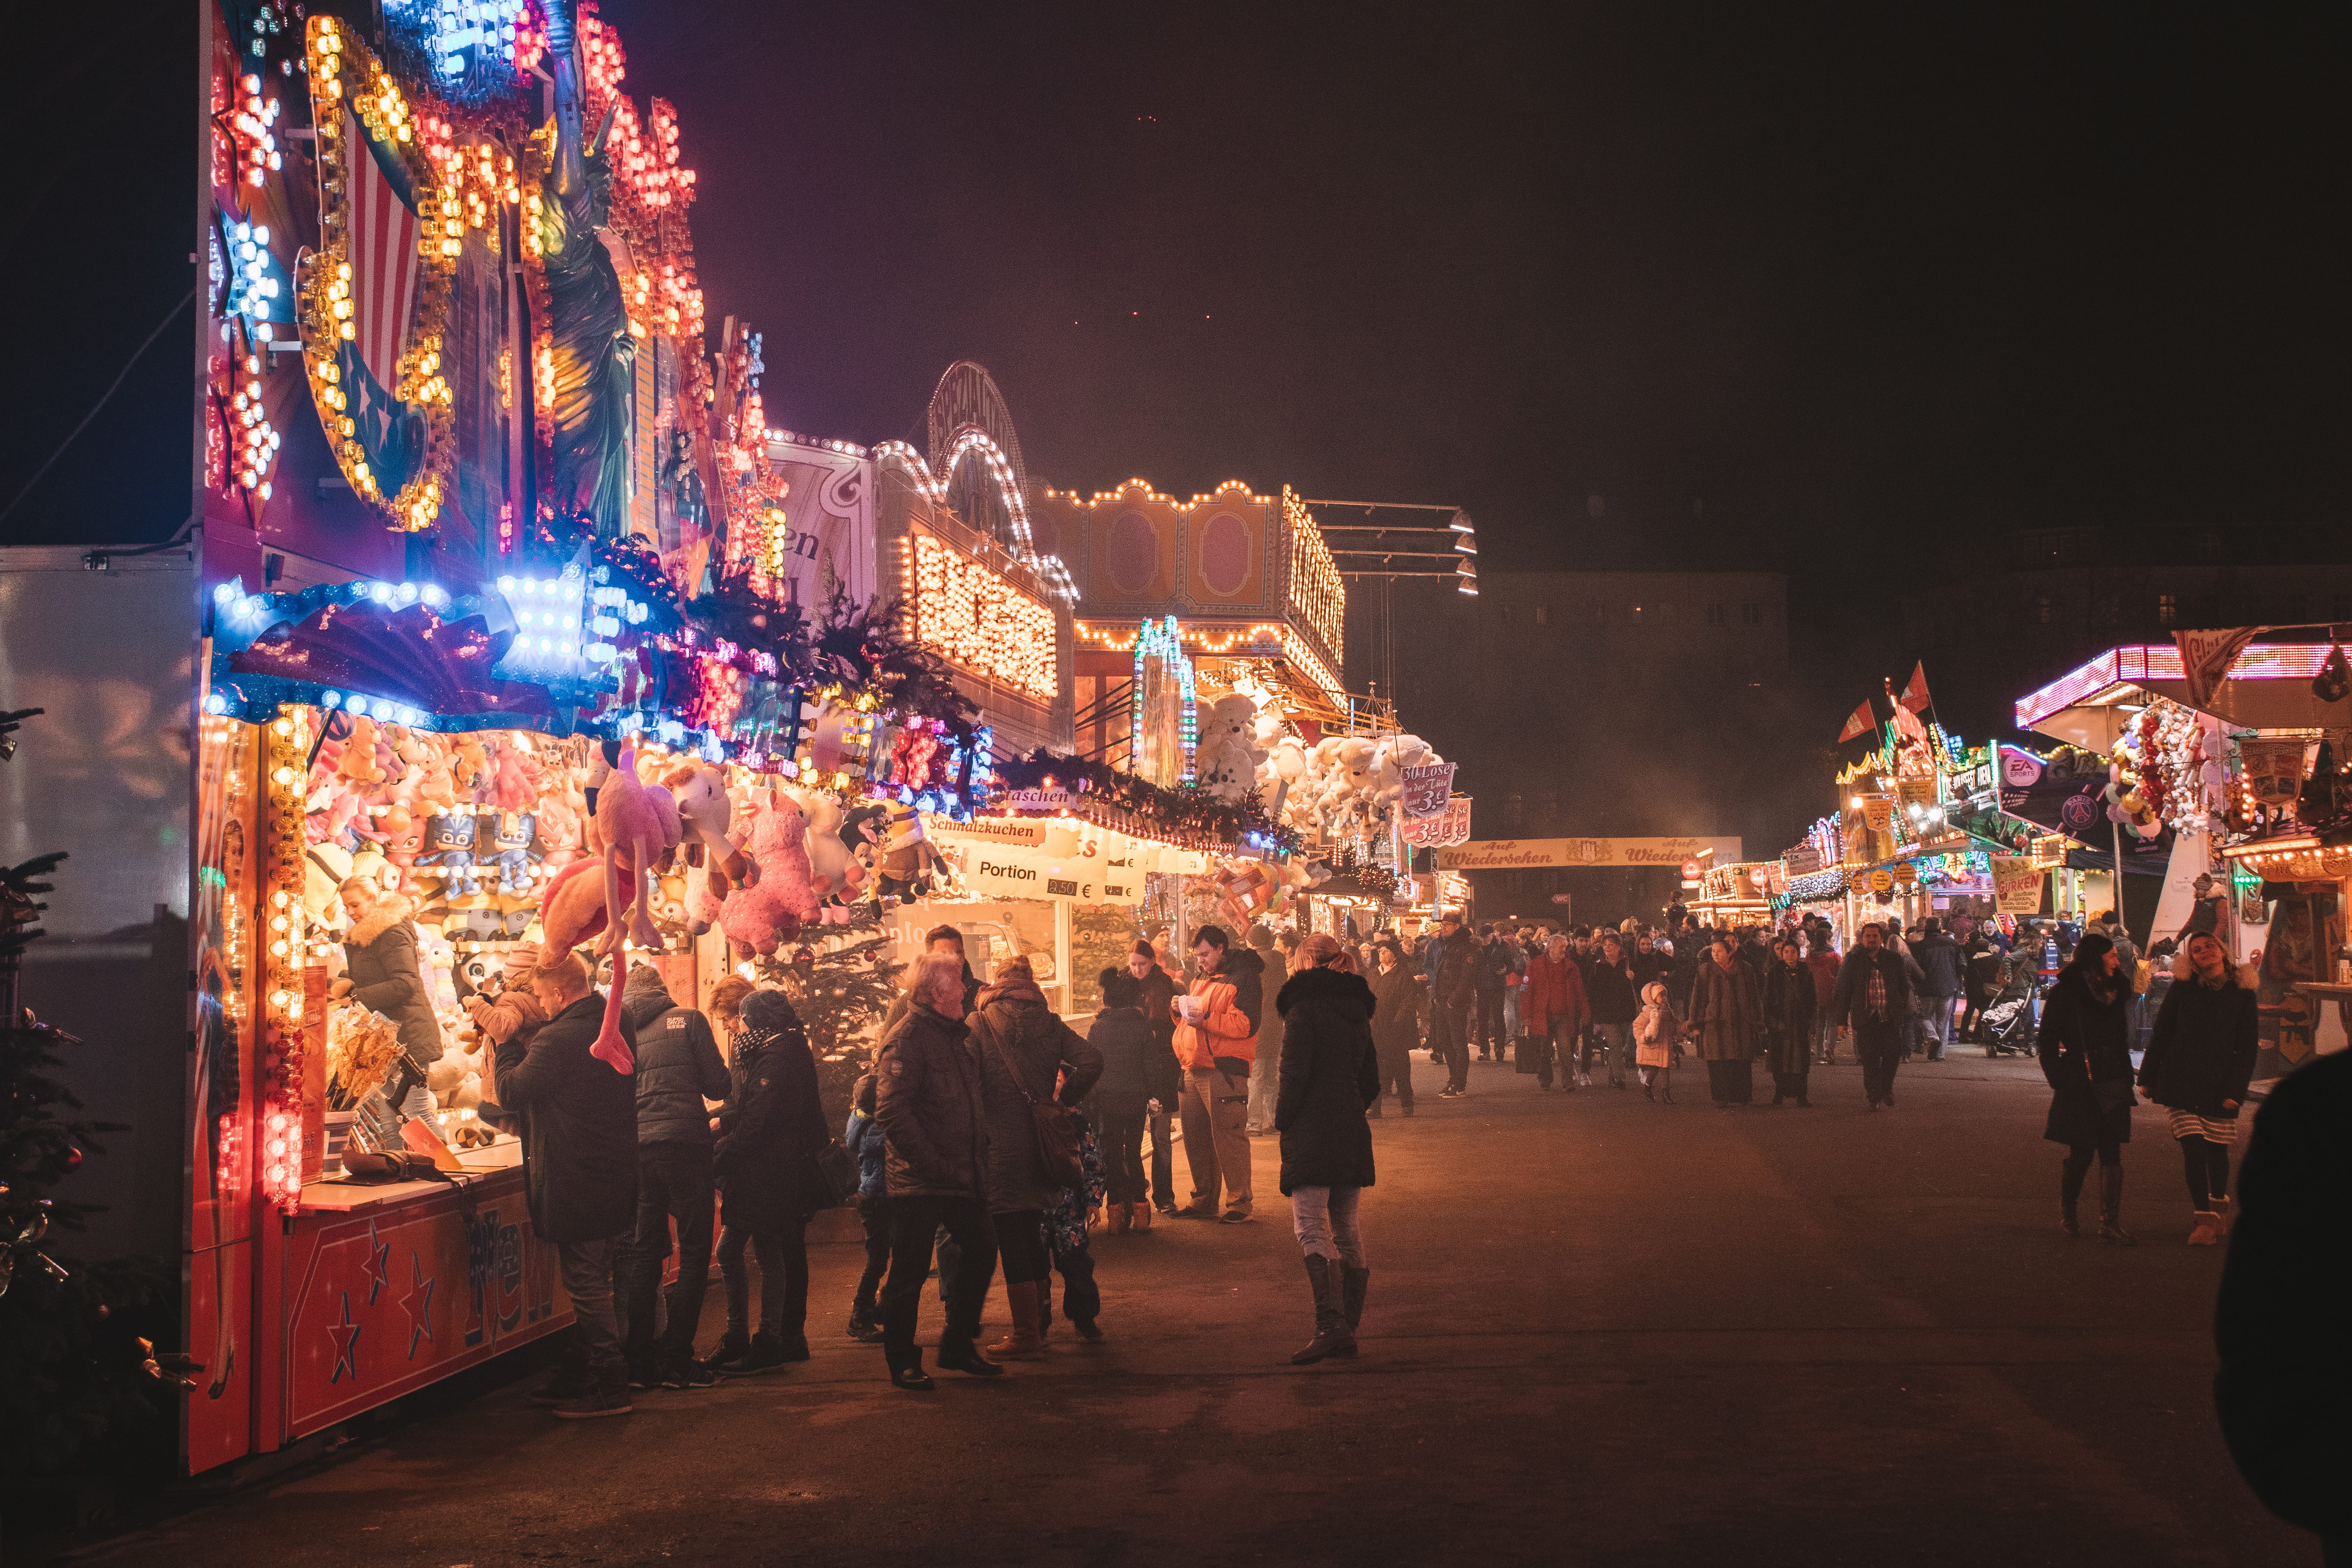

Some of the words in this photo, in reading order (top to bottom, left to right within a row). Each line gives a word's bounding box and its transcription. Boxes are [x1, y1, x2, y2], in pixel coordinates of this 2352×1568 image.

[2011, 759, 2034, 771] EA
[1404, 766, 1419, 781] 30
[1421, 765, 1450, 778] Lose
[1414, 783, 1425, 791] der
[1426, 779, 1448, 789] Tüte
[929, 818, 1033, 837] Schmalzkuchen
[1481, 841, 1517, 850] Auf
[1663, 838, 1697, 848] Auf
[1445, 851, 1553, 866] Wiedersehen
[980, 861, 1036, 881] Portion
[1082, 884, 1091, 898] €
[1999, 874, 2039, 894] GURKEN
